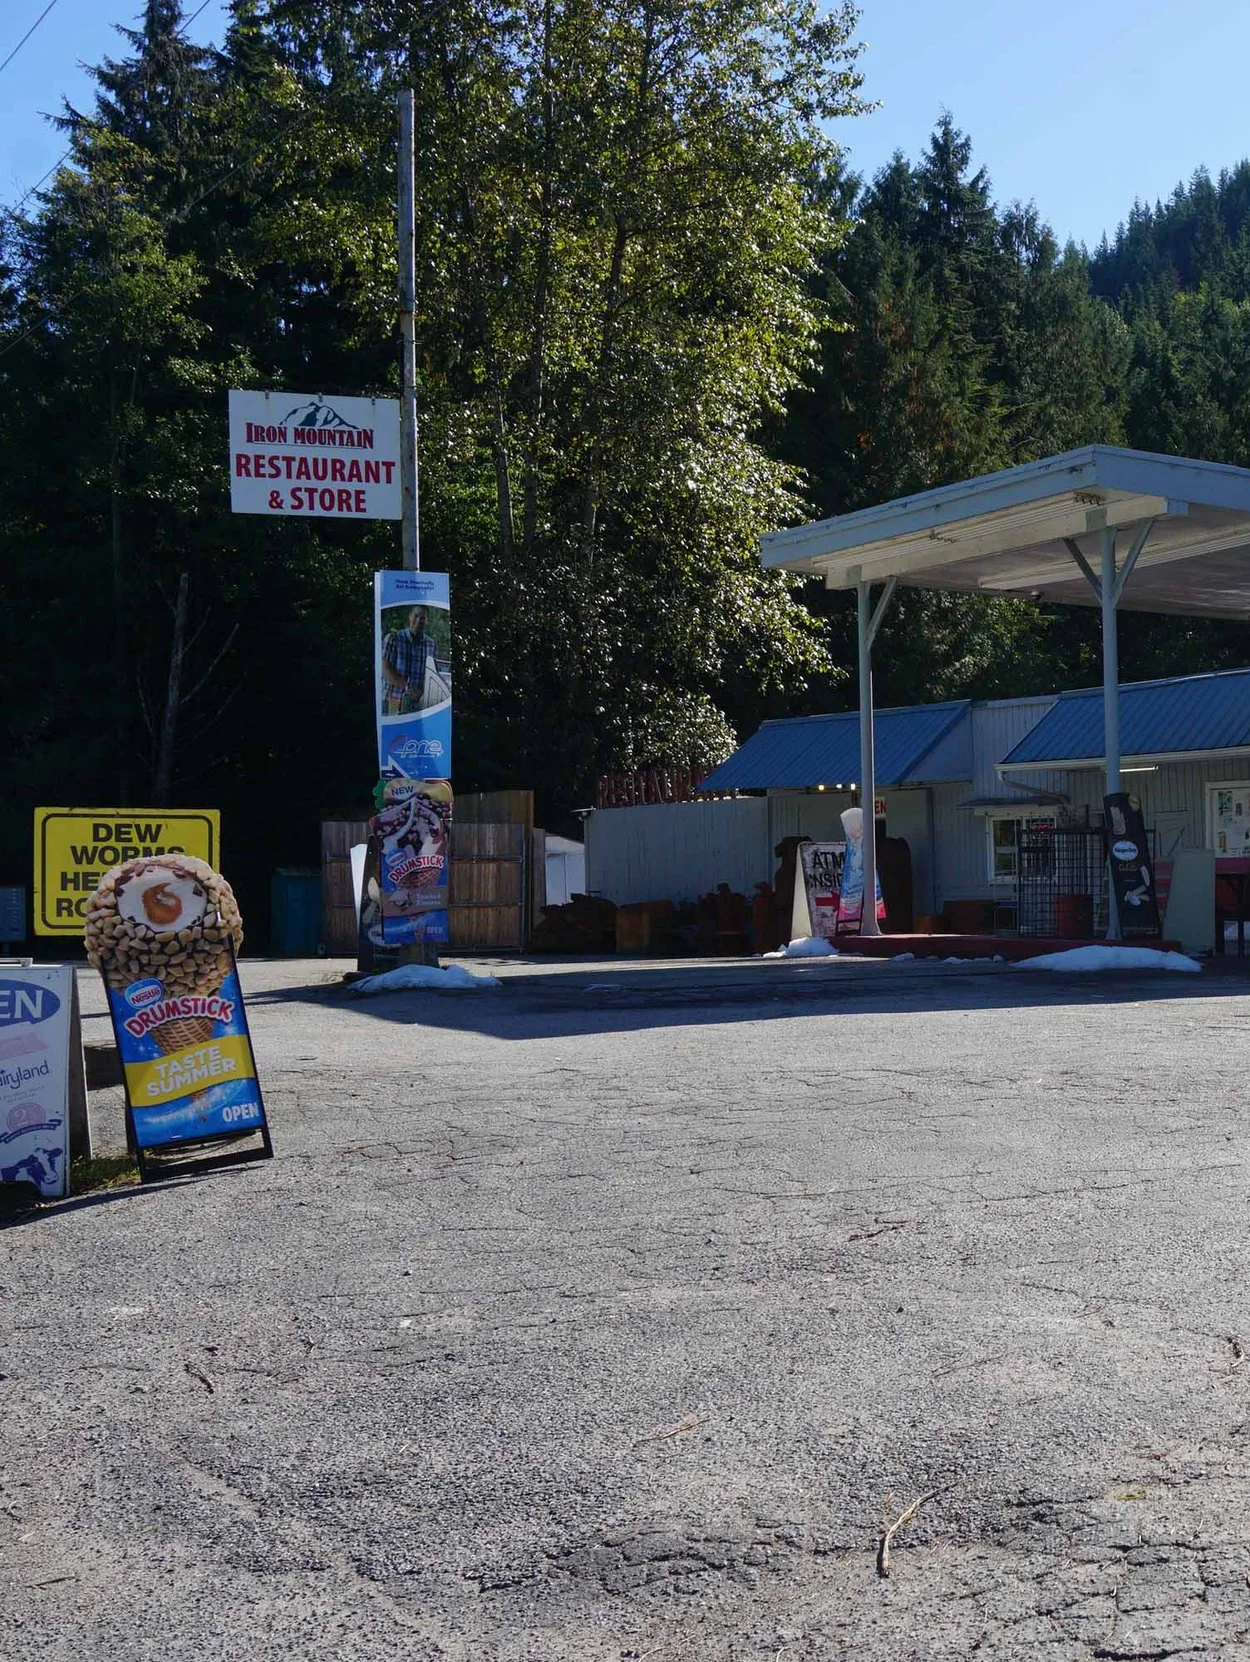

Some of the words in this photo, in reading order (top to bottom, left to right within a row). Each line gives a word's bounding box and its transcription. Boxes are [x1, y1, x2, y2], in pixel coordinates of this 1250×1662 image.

[246, 422, 288, 443] IRON
[294, 427, 374, 449] MOUNTAIN
[235, 453, 396, 484] RESTAURANT
[268, 490, 283, 509] &
[290, 487, 367, 512] STORE
[391, 785, 413, 796] NEW
[92, 823, 162, 843] DEW
[389, 855, 444, 883] DRUMSTICK
[813, 851, 845, 869] ATM
[810, 873, 843, 888] INSI
[56, 898, 88, 918] RO
[0, 990, 43, 1019] EN
[126, 997, 233, 1037] DRUMSTICK
[155, 1044, 221, 1078] TASTE
[147, 1058, 236, 1096] SUMMER
[222, 1103, 260, 1122] OPEN
